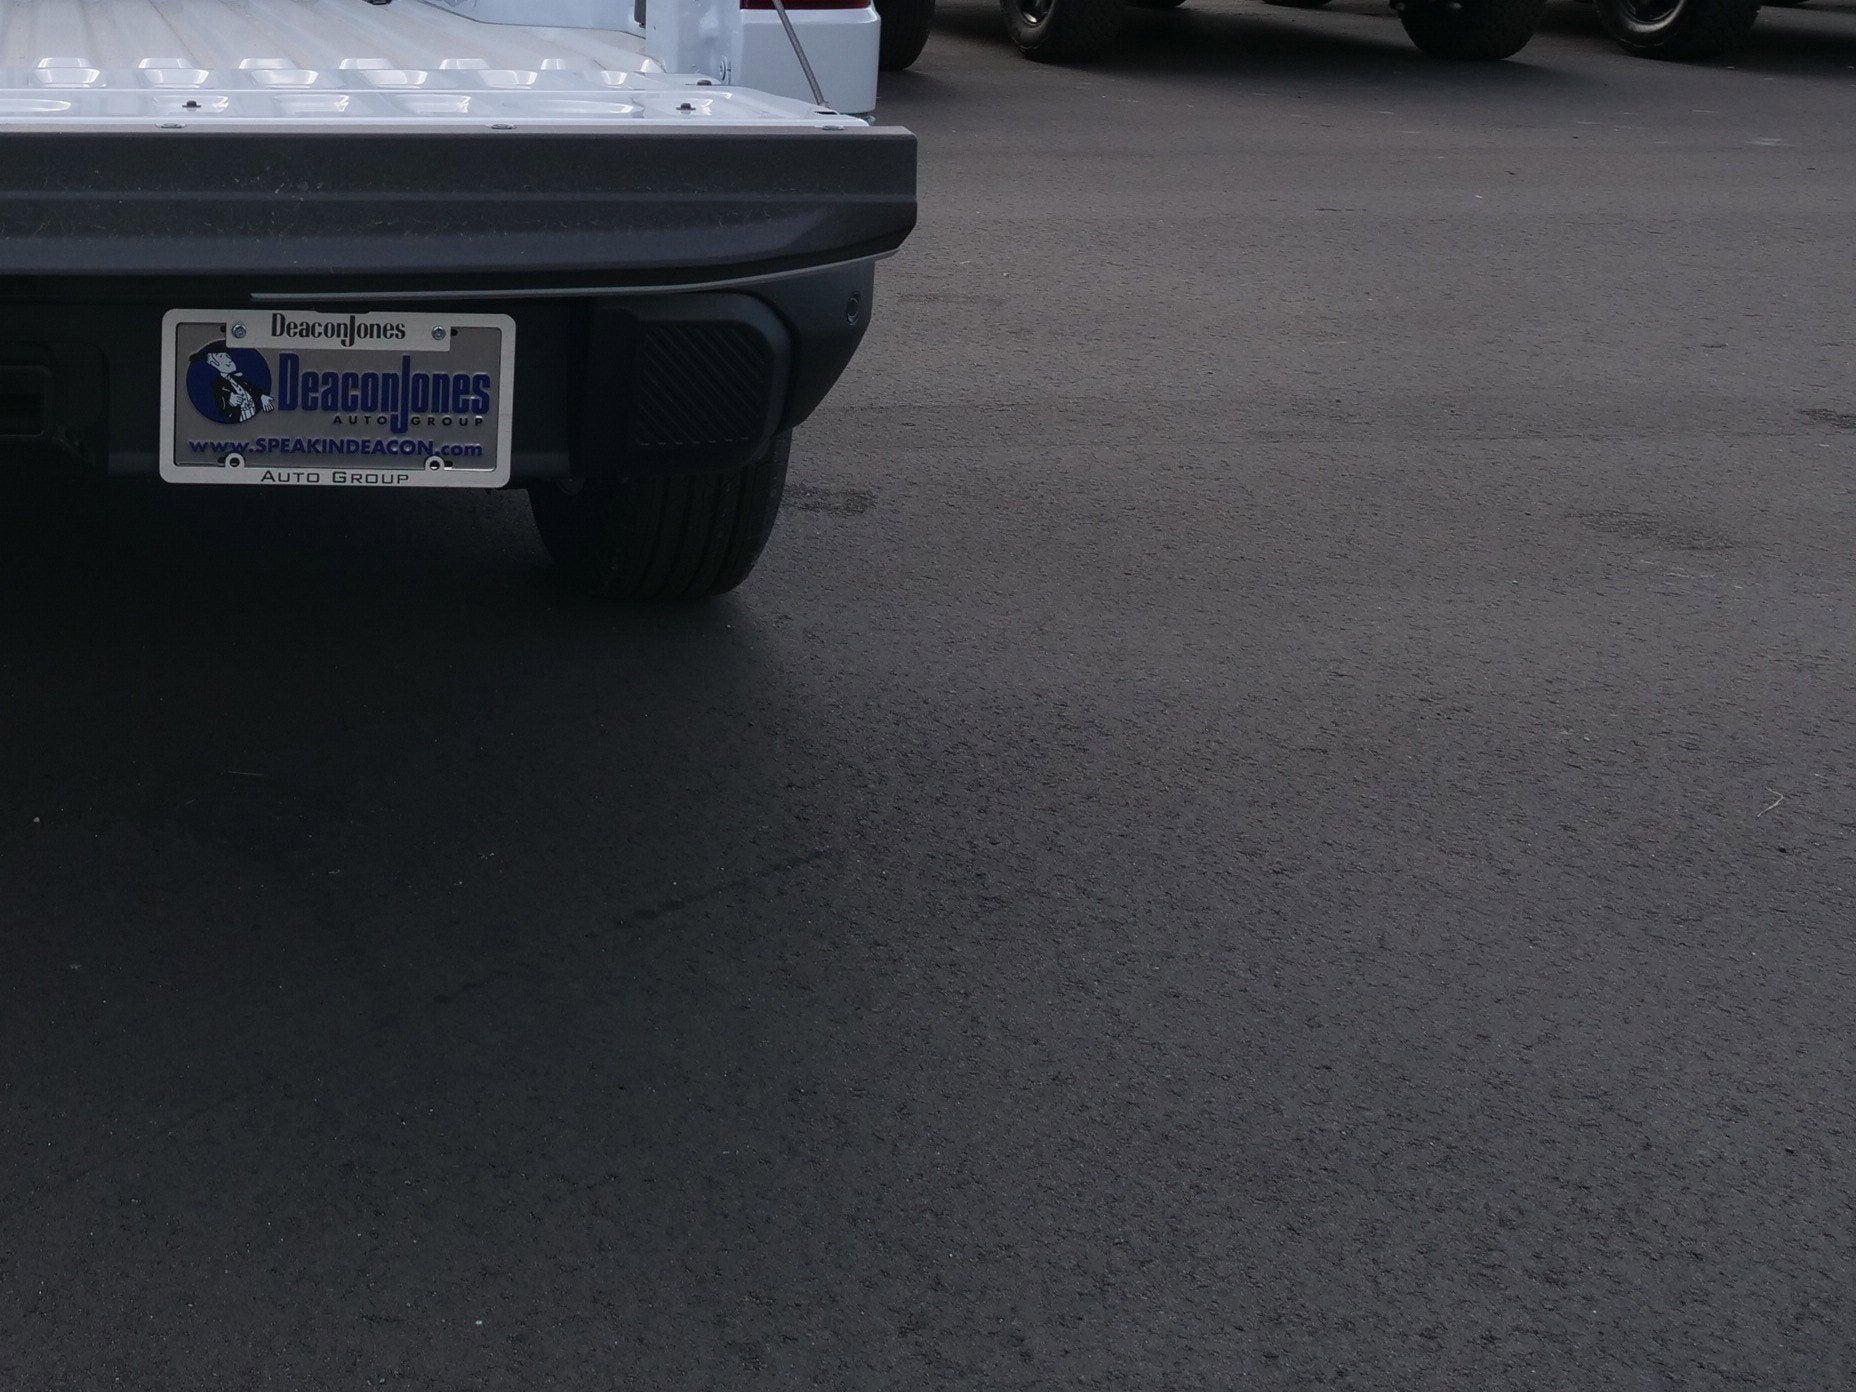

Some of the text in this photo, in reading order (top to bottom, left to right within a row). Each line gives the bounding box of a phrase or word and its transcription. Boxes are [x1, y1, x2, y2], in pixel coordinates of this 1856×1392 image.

[333, 415, 483, 426] AUTO GROUP
[189, 437, 483, 457] www.SPEAKINDEACON.com
